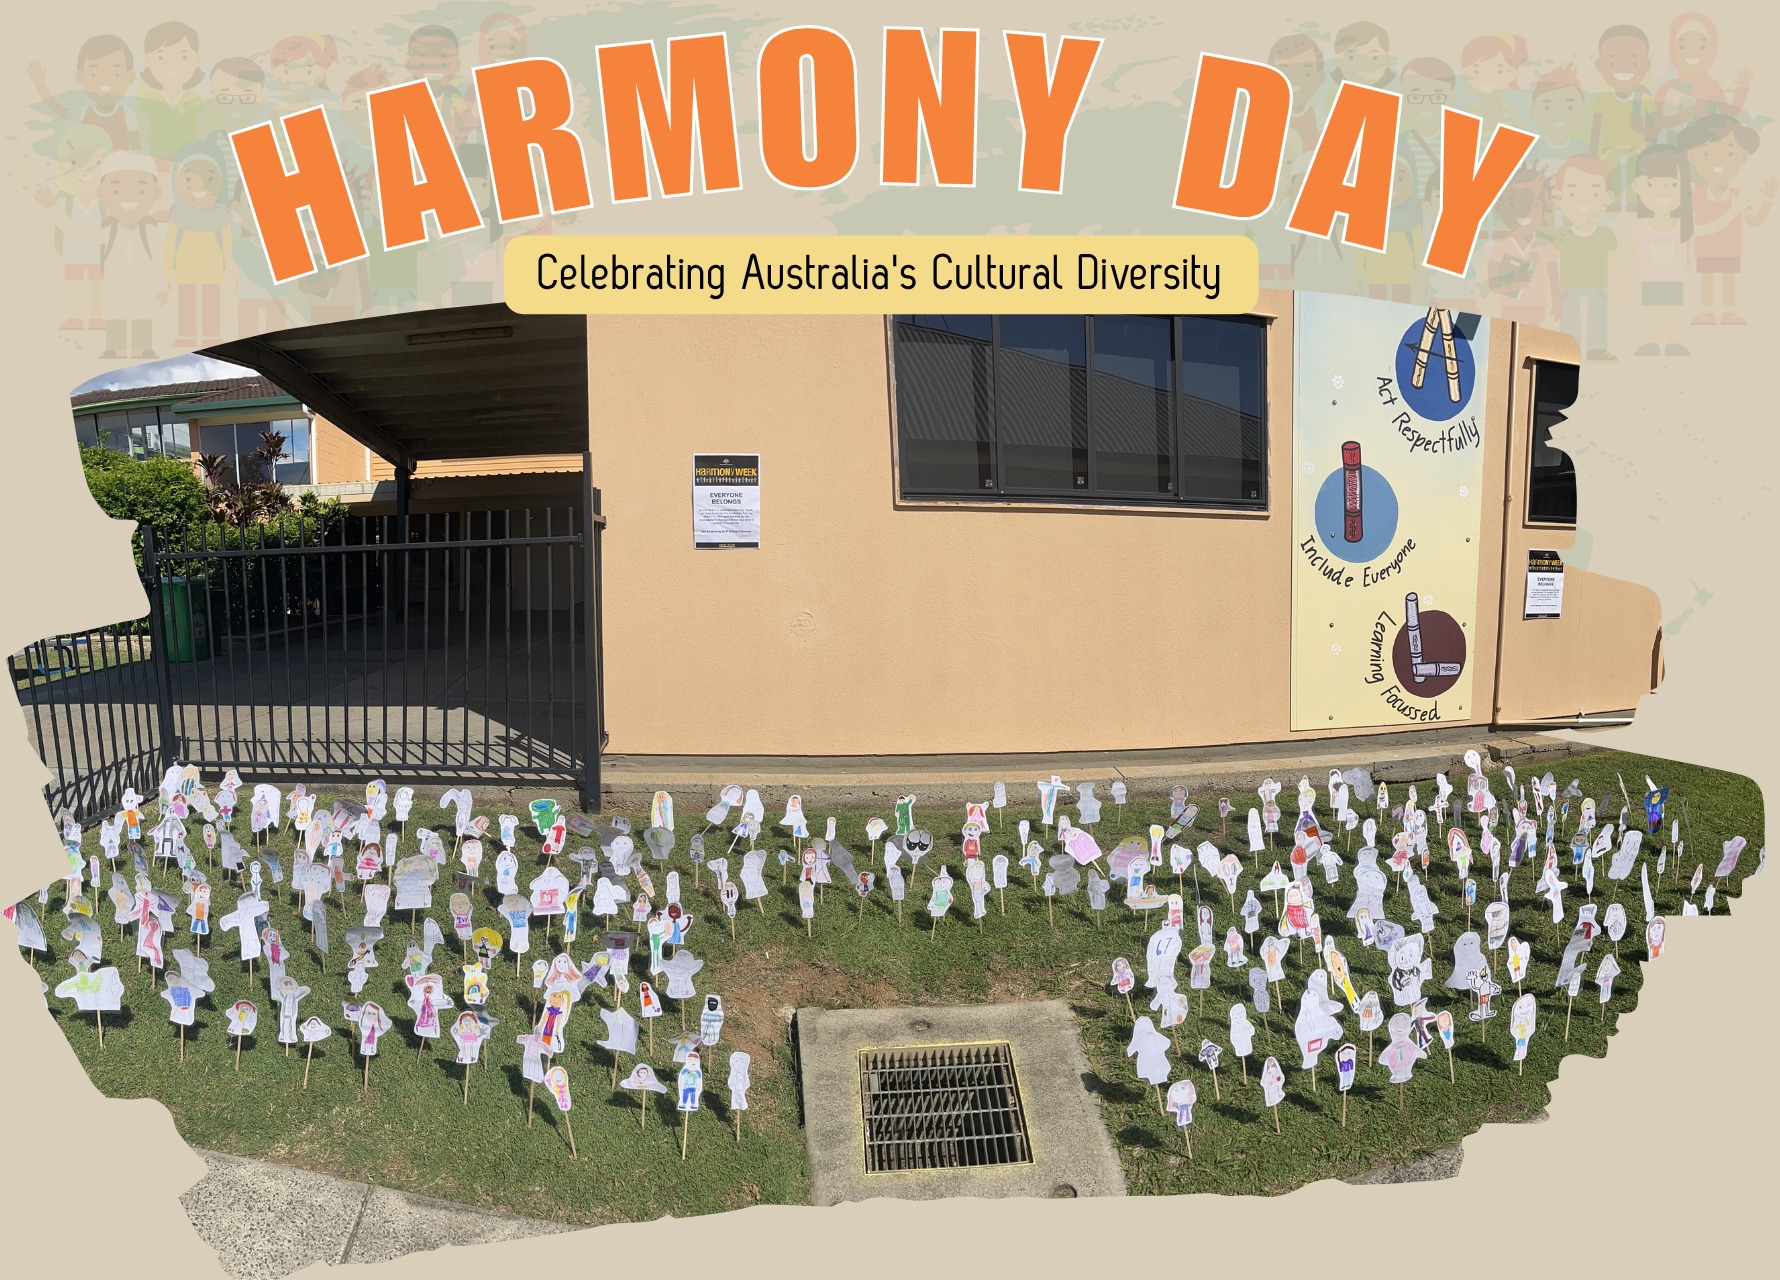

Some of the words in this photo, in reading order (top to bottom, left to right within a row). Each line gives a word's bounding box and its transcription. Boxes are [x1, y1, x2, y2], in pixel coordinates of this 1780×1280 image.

[1376, 376, 1398, 406] Act
[1391, 411, 1481, 455] Respectfully
[736, 468, 757, 476] WEEK
[1300, 534, 1354, 587] Include
[1363, 538, 1416, 587] Everyone
[1364, 610, 1397, 684] Learning
[1380, 684, 1441, 721] Focussed
[1156, 936, 1173, 956] 67
